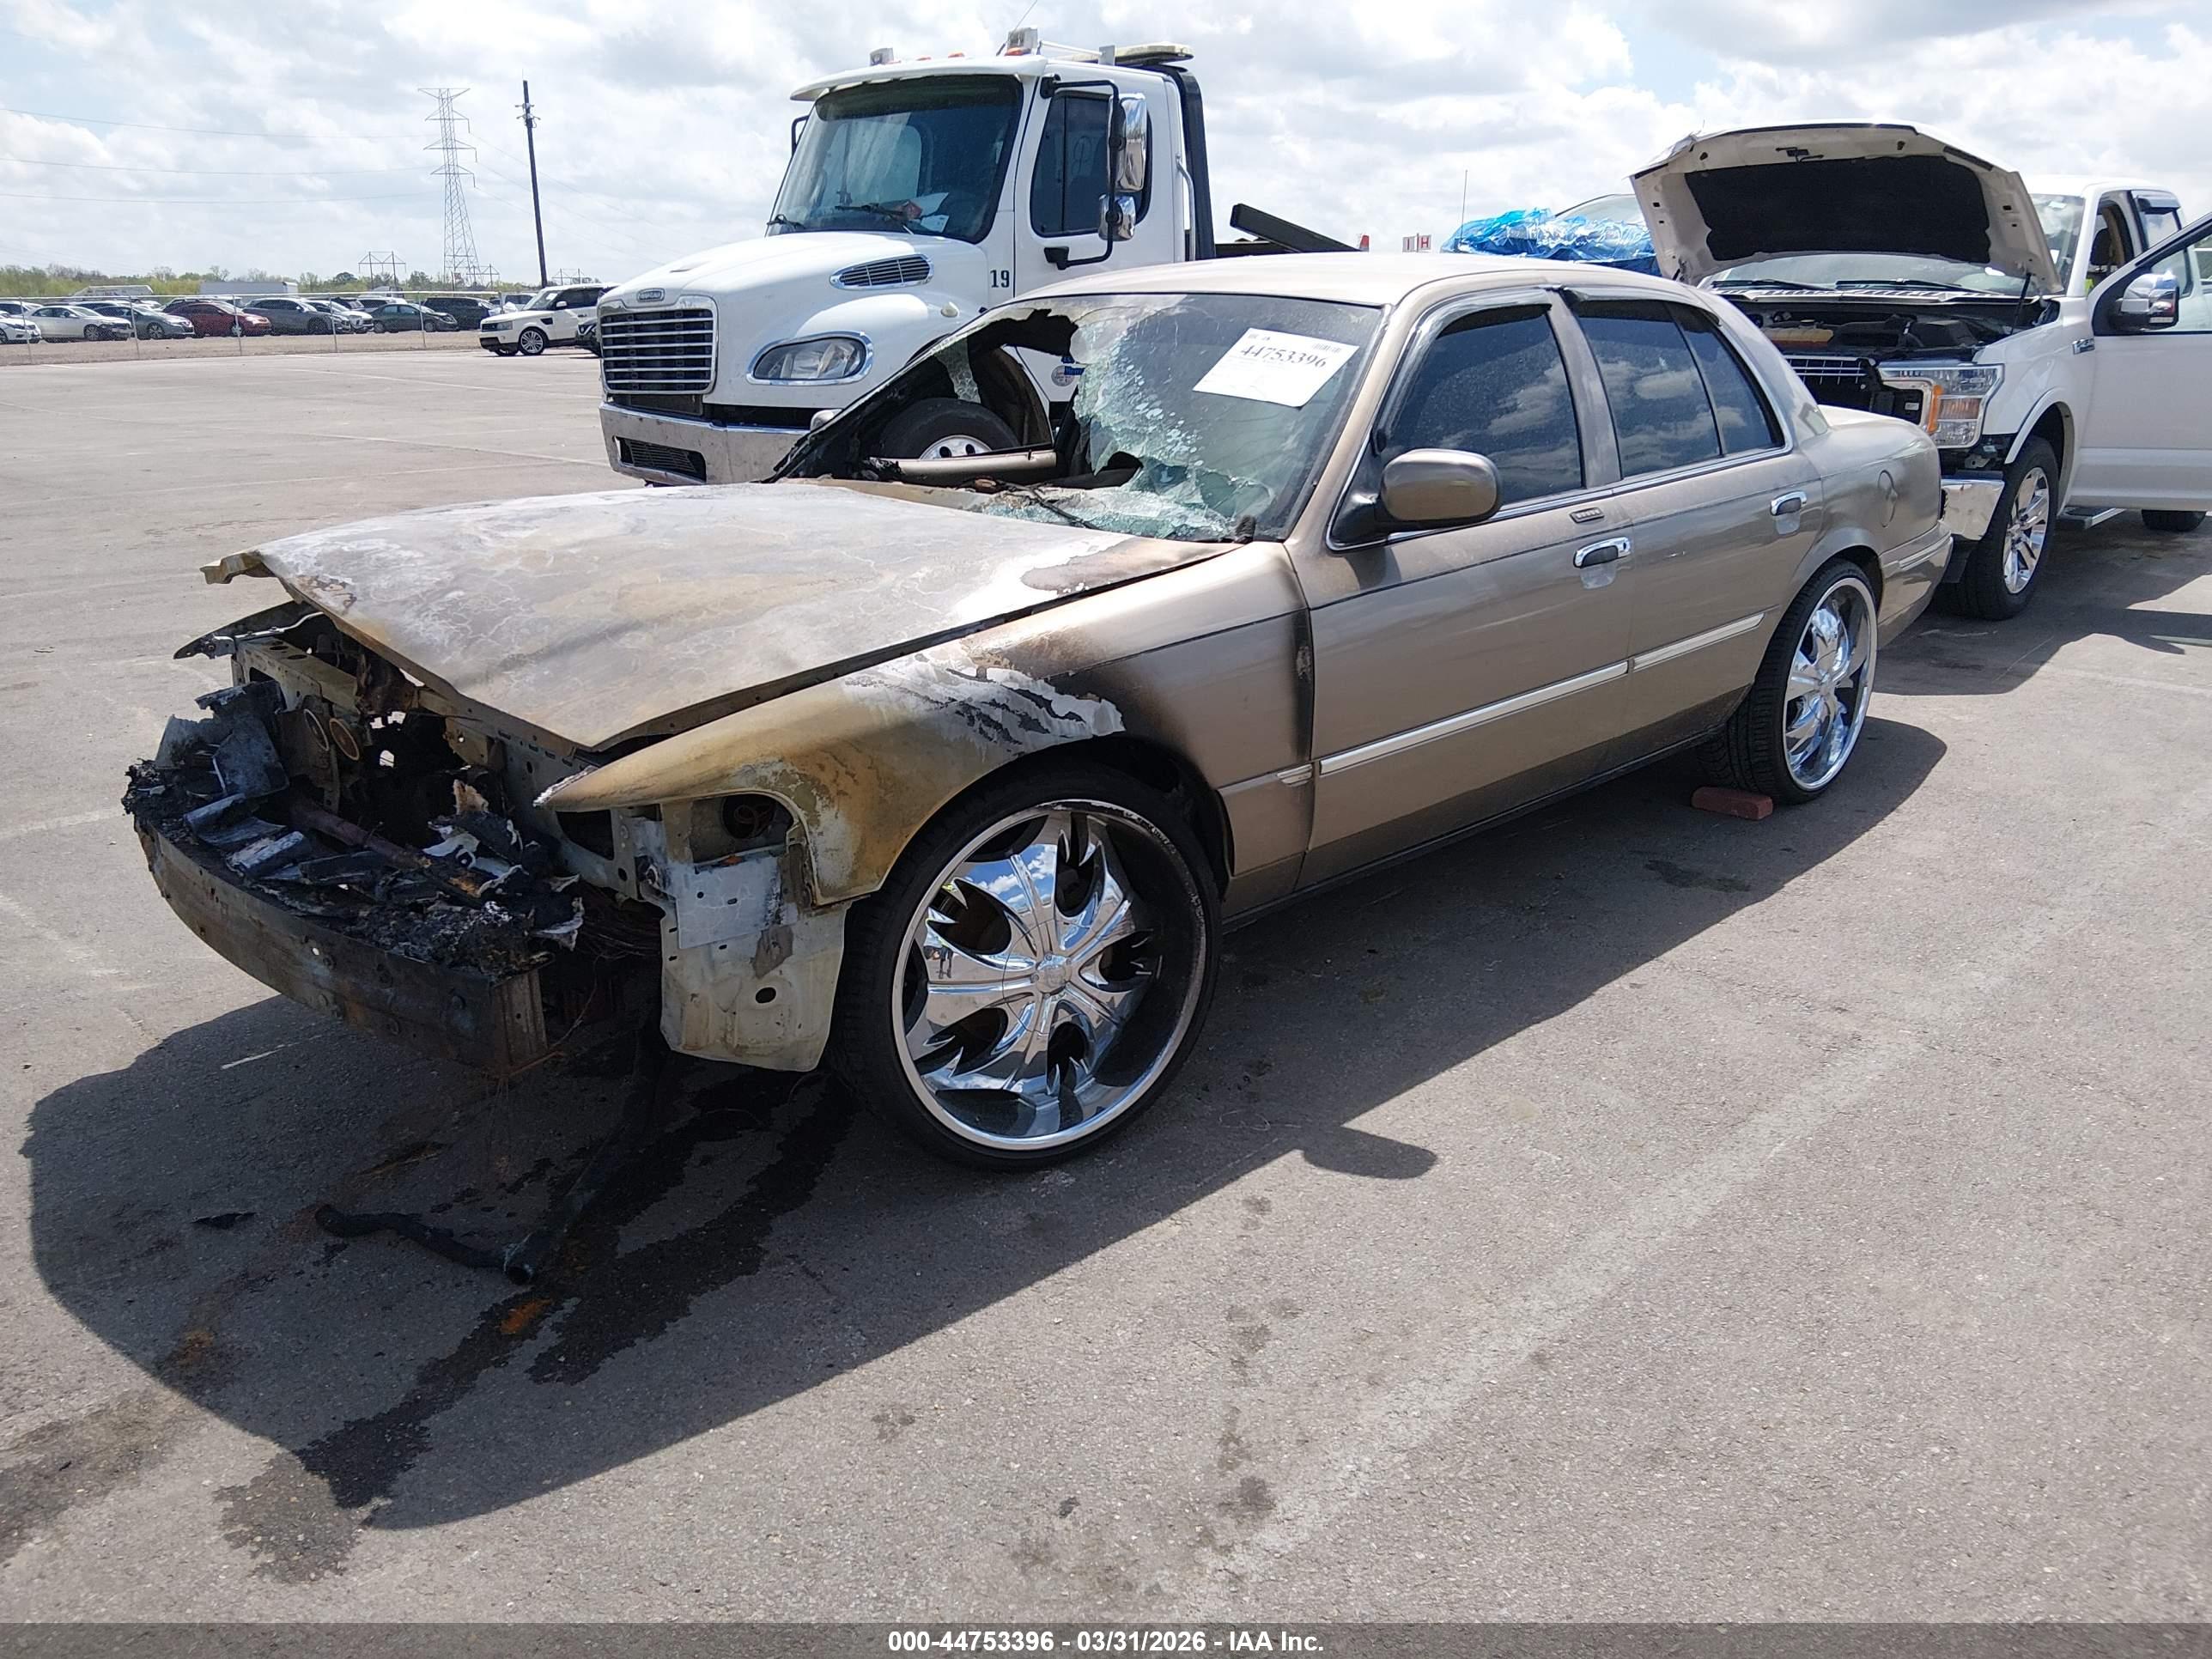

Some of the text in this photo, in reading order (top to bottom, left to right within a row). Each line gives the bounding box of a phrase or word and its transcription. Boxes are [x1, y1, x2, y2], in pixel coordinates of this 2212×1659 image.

[1421, 237, 1430, 248] H
[990, 270, 1010, 289] 19
[1240, 344, 1328, 368] 44753396
